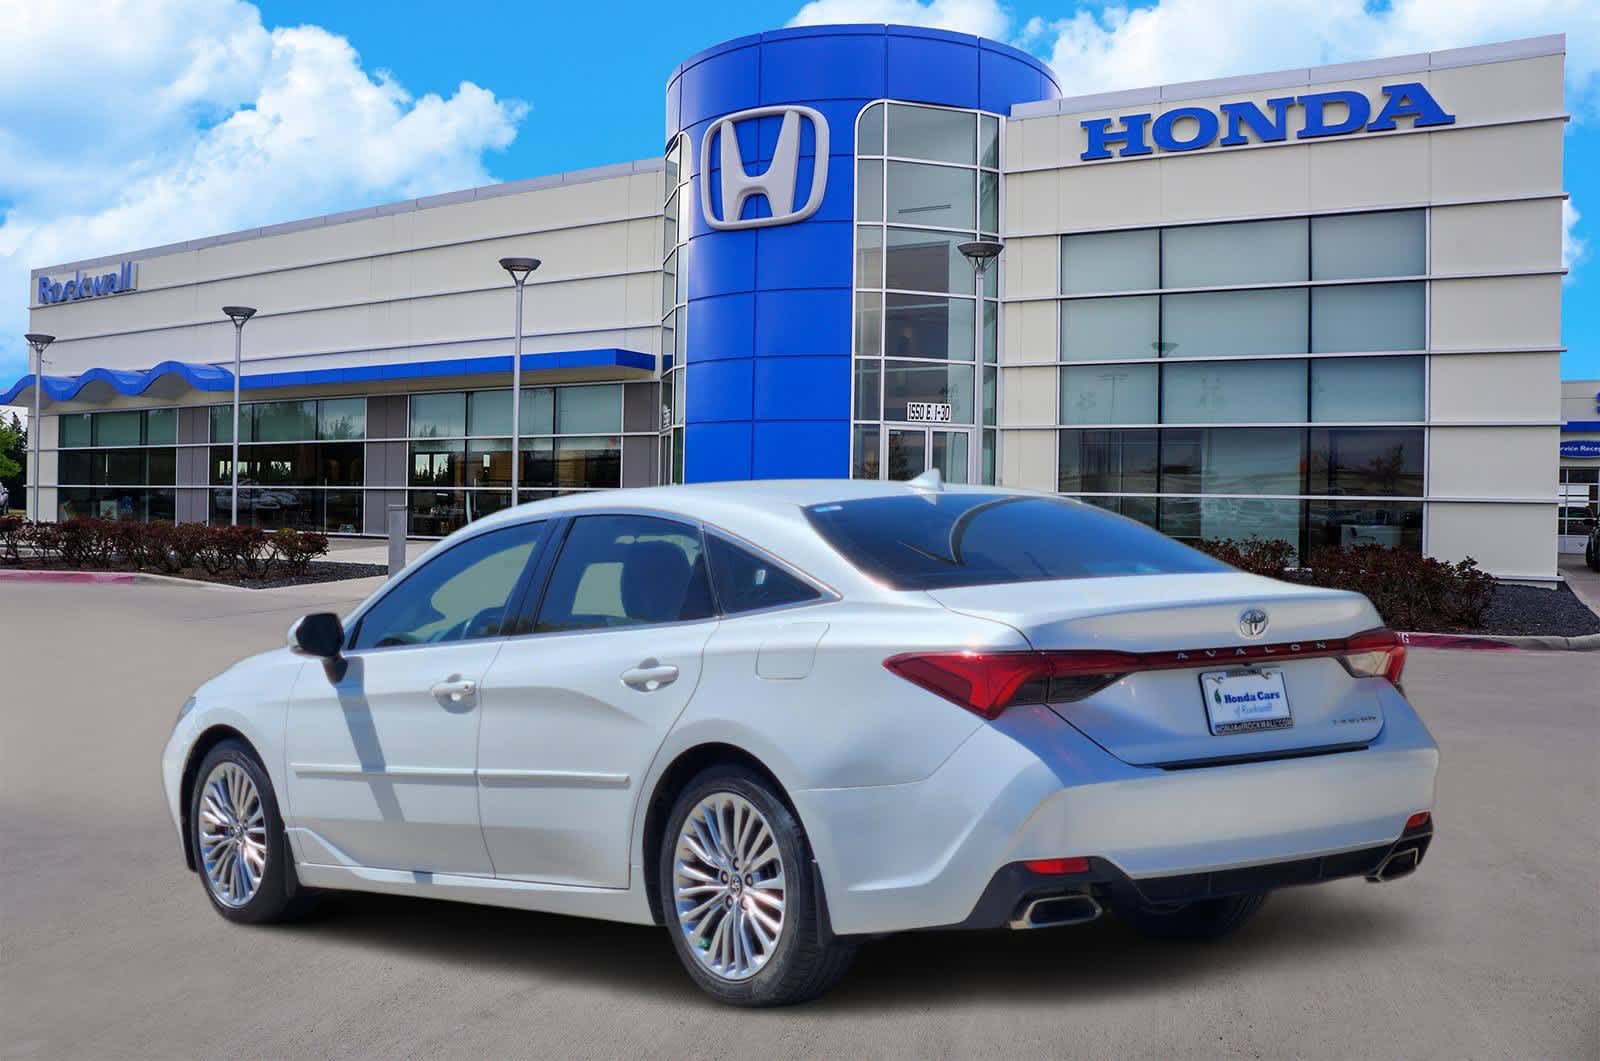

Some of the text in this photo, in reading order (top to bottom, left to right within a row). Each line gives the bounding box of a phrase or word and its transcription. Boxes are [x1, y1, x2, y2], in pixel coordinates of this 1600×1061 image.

[1080, 82, 1456, 161] HONDA
[38, 261, 132, 304] Rockwall
[908, 403, 925, 420] 1550
[1177, 640, 1326, 660] AVALON
[1223, 691, 1280, 704] Honda Cars
